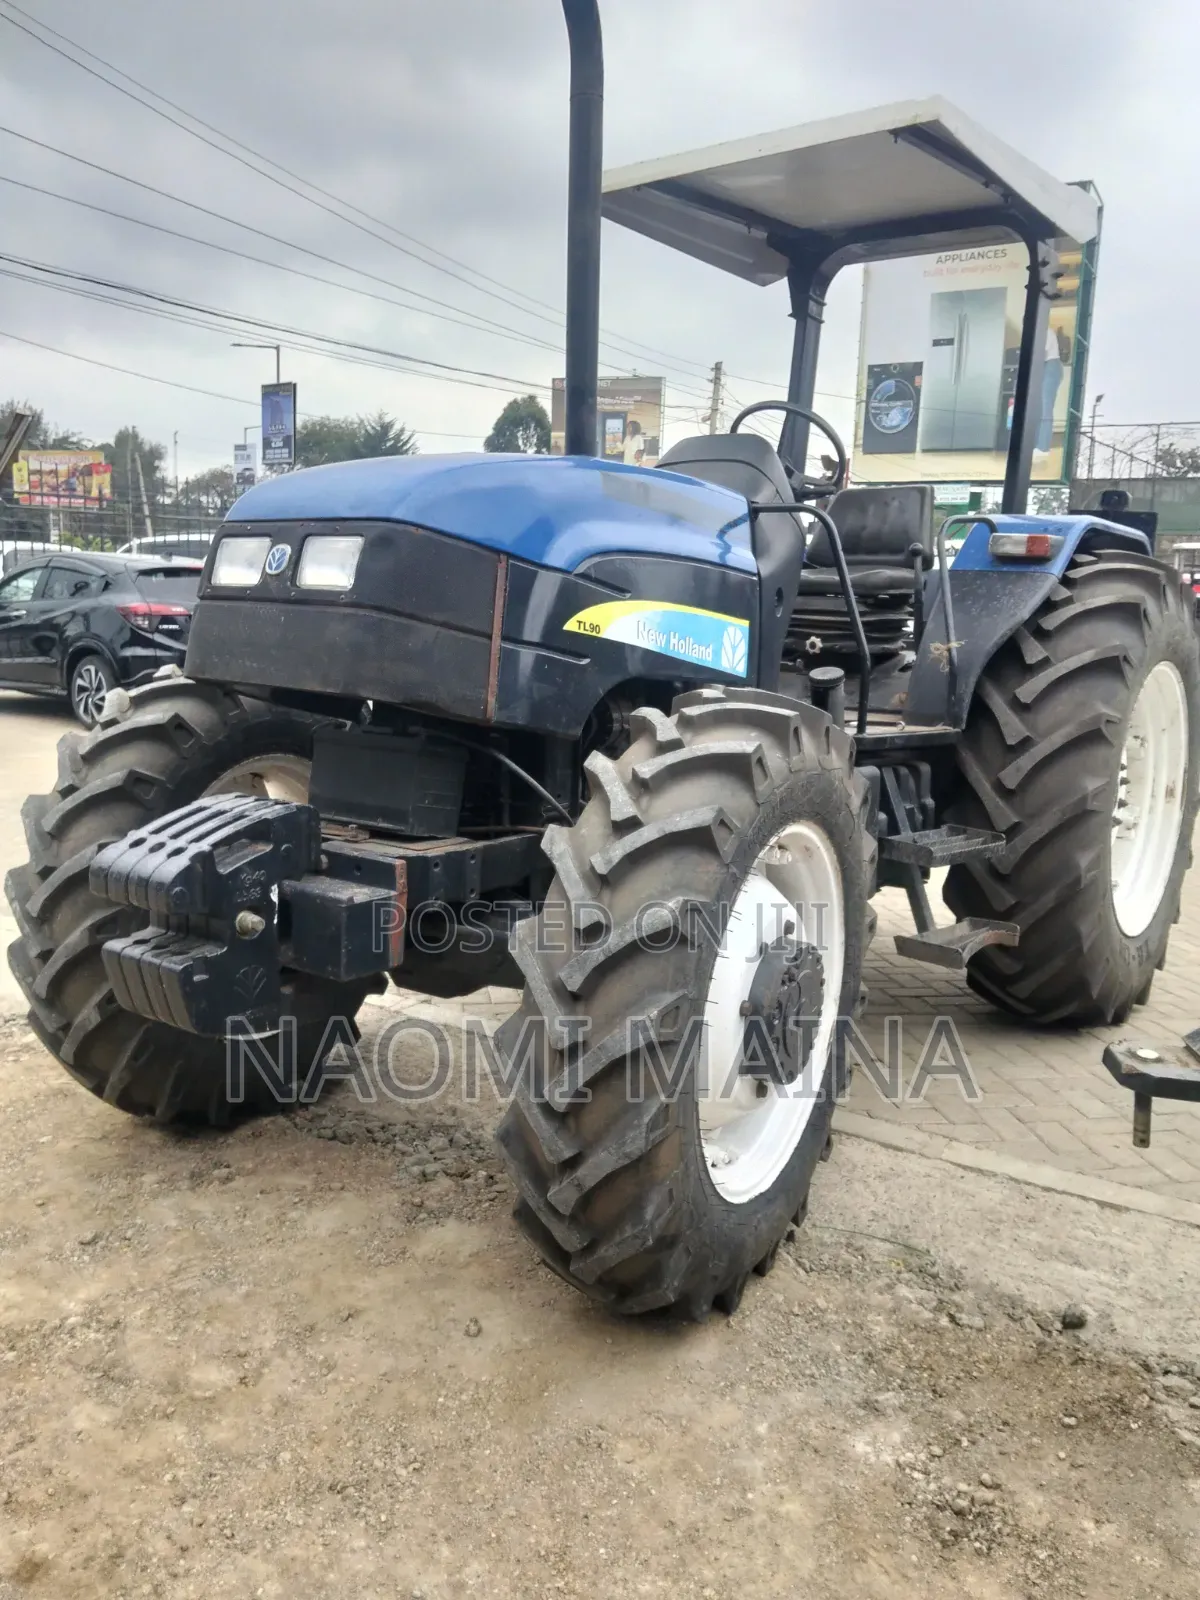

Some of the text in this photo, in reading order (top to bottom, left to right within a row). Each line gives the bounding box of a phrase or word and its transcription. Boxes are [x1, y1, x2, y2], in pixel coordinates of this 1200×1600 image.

[936, 249, 1008, 265] APPLIANCES
[576, 619, 601, 635] TL90
[636, 619, 713, 662] New Holland
